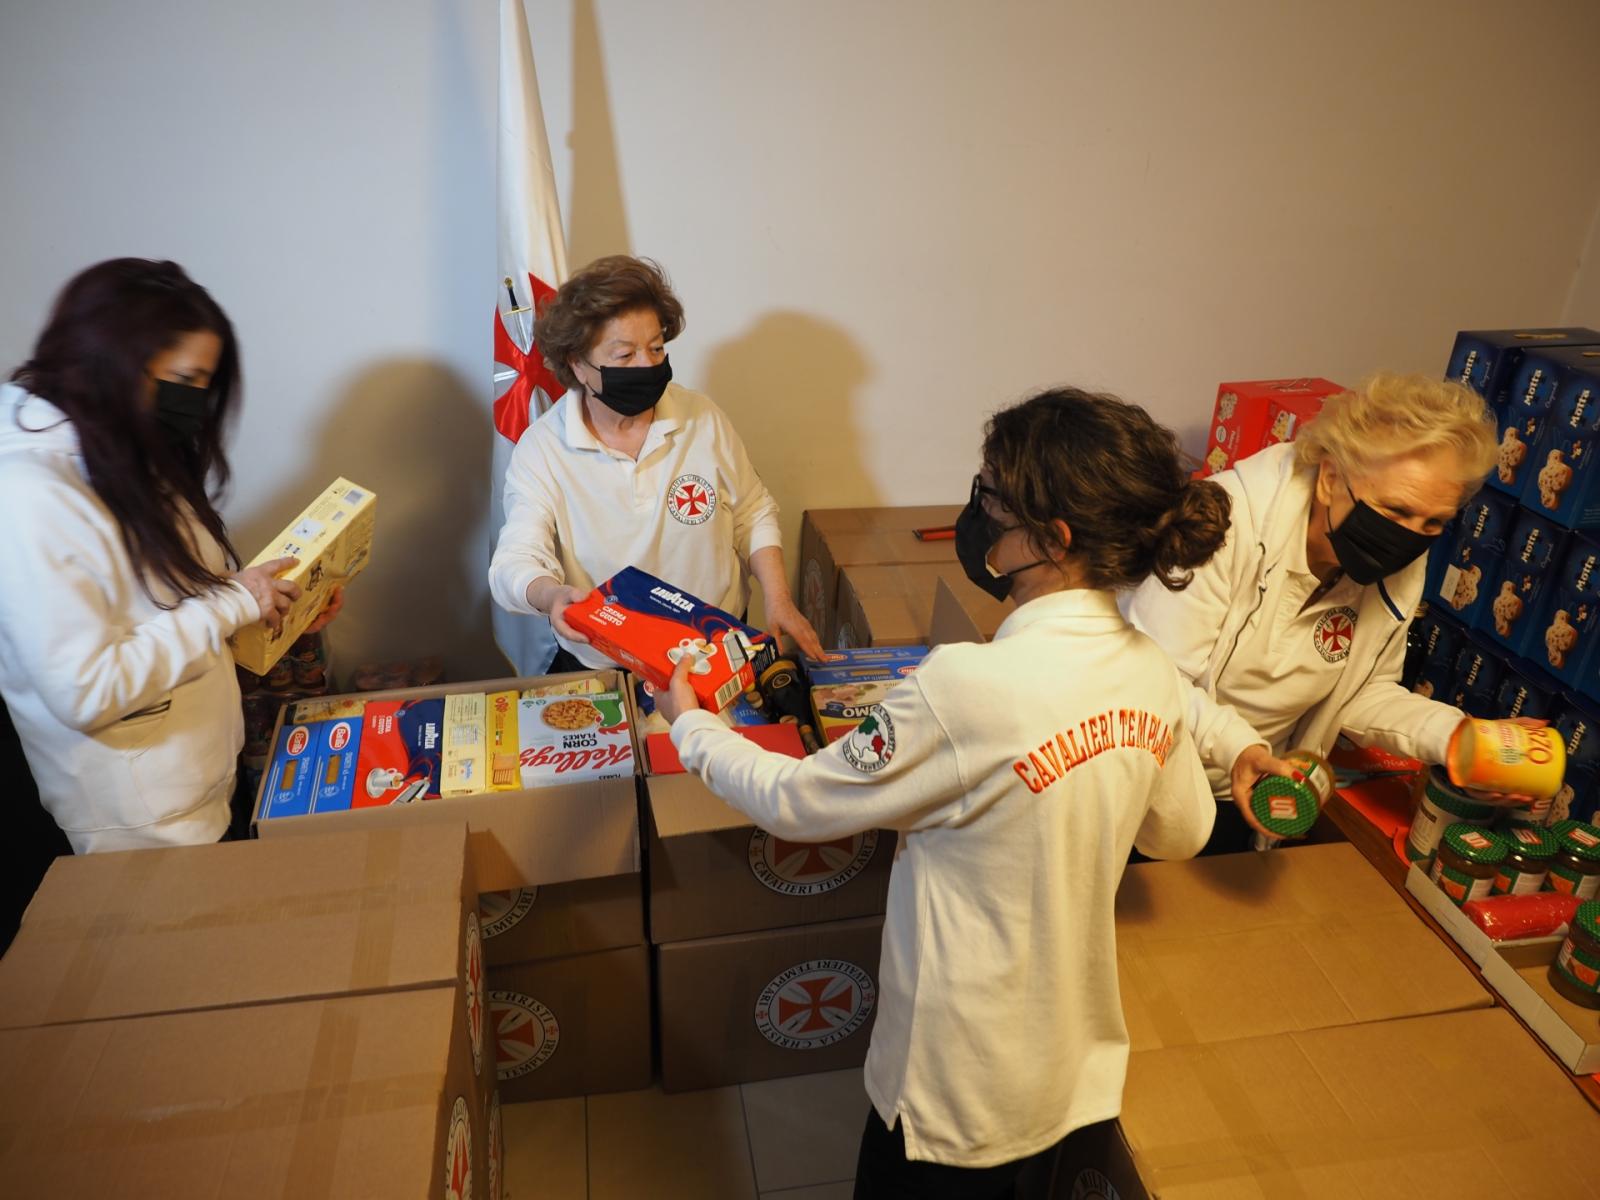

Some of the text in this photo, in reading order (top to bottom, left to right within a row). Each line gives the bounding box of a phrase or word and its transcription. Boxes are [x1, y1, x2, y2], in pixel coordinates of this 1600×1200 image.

[1524, 368, 1543, 406] Motta
[1570, 389, 1591, 428] Motta
[1521, 528, 1540, 563] Motta
[1575, 555, 1596, 591] Motta
[602, 606, 627, 621] CREMA
[650, 586, 695, 613] LAVAZZA
[599, 612, 624, 626] GUSTO
[563, 732, 597, 741] FLAKES
[563, 739, 598, 749] CORN
[1013, 710, 1116, 794] CAVALIERI
[1567, 721, 1586, 755] Motta
[753, 845, 874, 894] CAVALIERI TEMPLARI
[485, 892, 534, 937] EMPLARI
[759, 962, 871, 1006] CAVALIERI TEMPLARI
[492, 990, 554, 1022] CHRISTI
[760, 1006, 870, 1049] MILITIA CHRISTI
[504, 1039, 557, 1078] TEMPLARI
